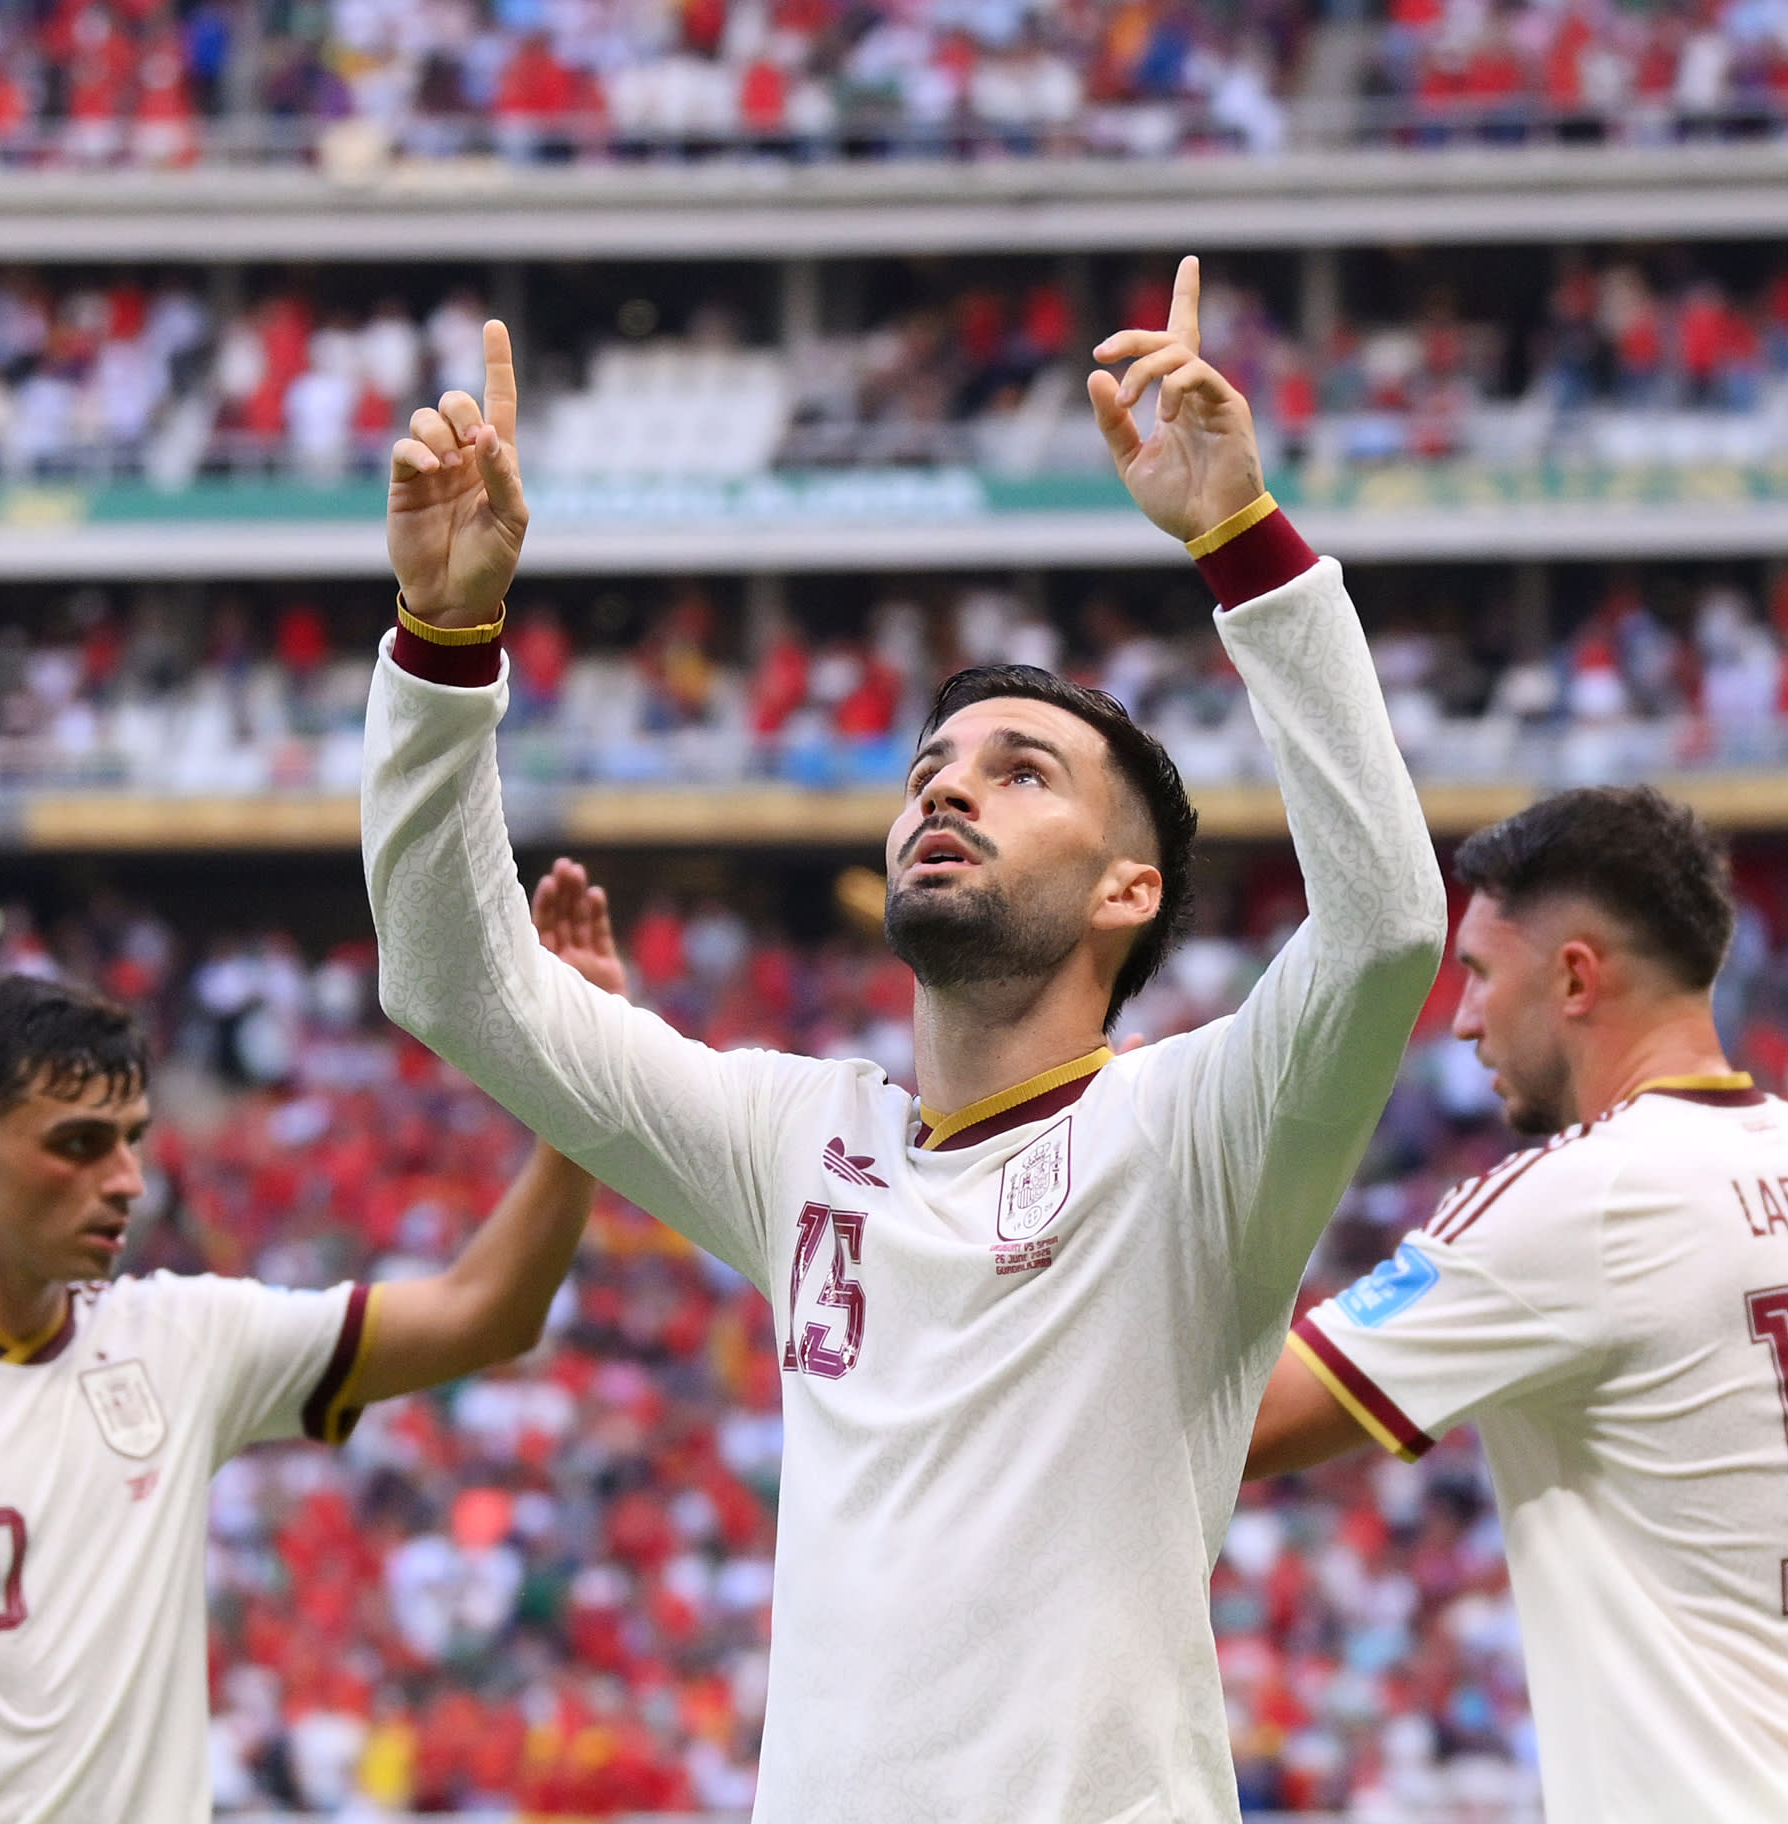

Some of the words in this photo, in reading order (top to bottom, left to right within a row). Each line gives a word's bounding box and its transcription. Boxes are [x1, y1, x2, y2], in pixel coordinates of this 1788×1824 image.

[782, 1200, 869, 1381] 15
[995, 1254, 1006, 1264] 26
[1008, 1253, 1028, 1264] JUNE
